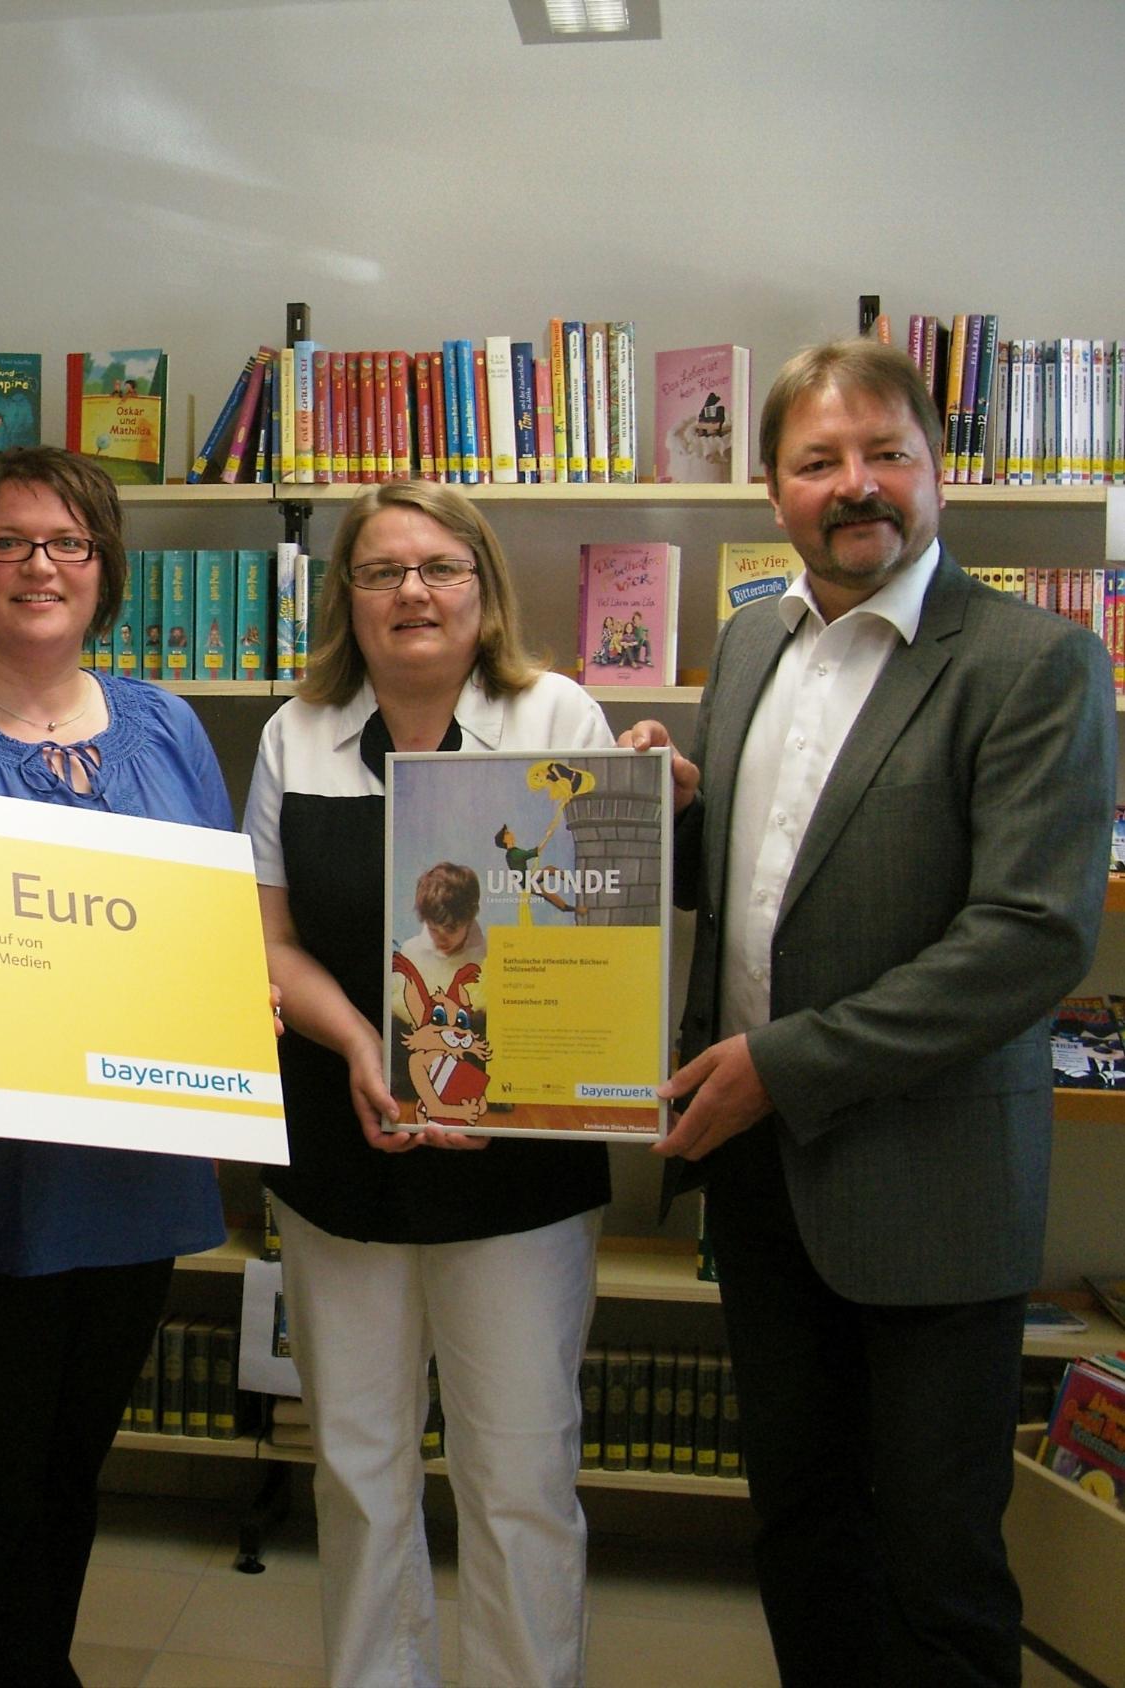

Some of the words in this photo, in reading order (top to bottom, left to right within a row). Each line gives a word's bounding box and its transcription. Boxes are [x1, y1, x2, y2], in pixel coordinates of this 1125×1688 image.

[554, 345, 562, 361] Dich
[116, 406, 145, 416] Oskar
[119, 417, 136, 425] und
[518, 412, 533, 431] Tom
[949, 414, 959, 422] 9
[964, 415, 973, 423] 11
[978, 414, 987, 426] 12
[109, 425, 151, 436] Mathilda
[735, 557, 759, 573] Wir
[1117, 577, 1125, 591] 2
[732, 580, 783, 604] Ritterstraße
[487, 869, 620, 894] URKUNDE
[12, 871, 138, 932] Euro
[17, 937, 43, 949] von
[101, 1057, 252, 1094] bayernwerk
[581, 1085, 653, 1097] bayernwerk
